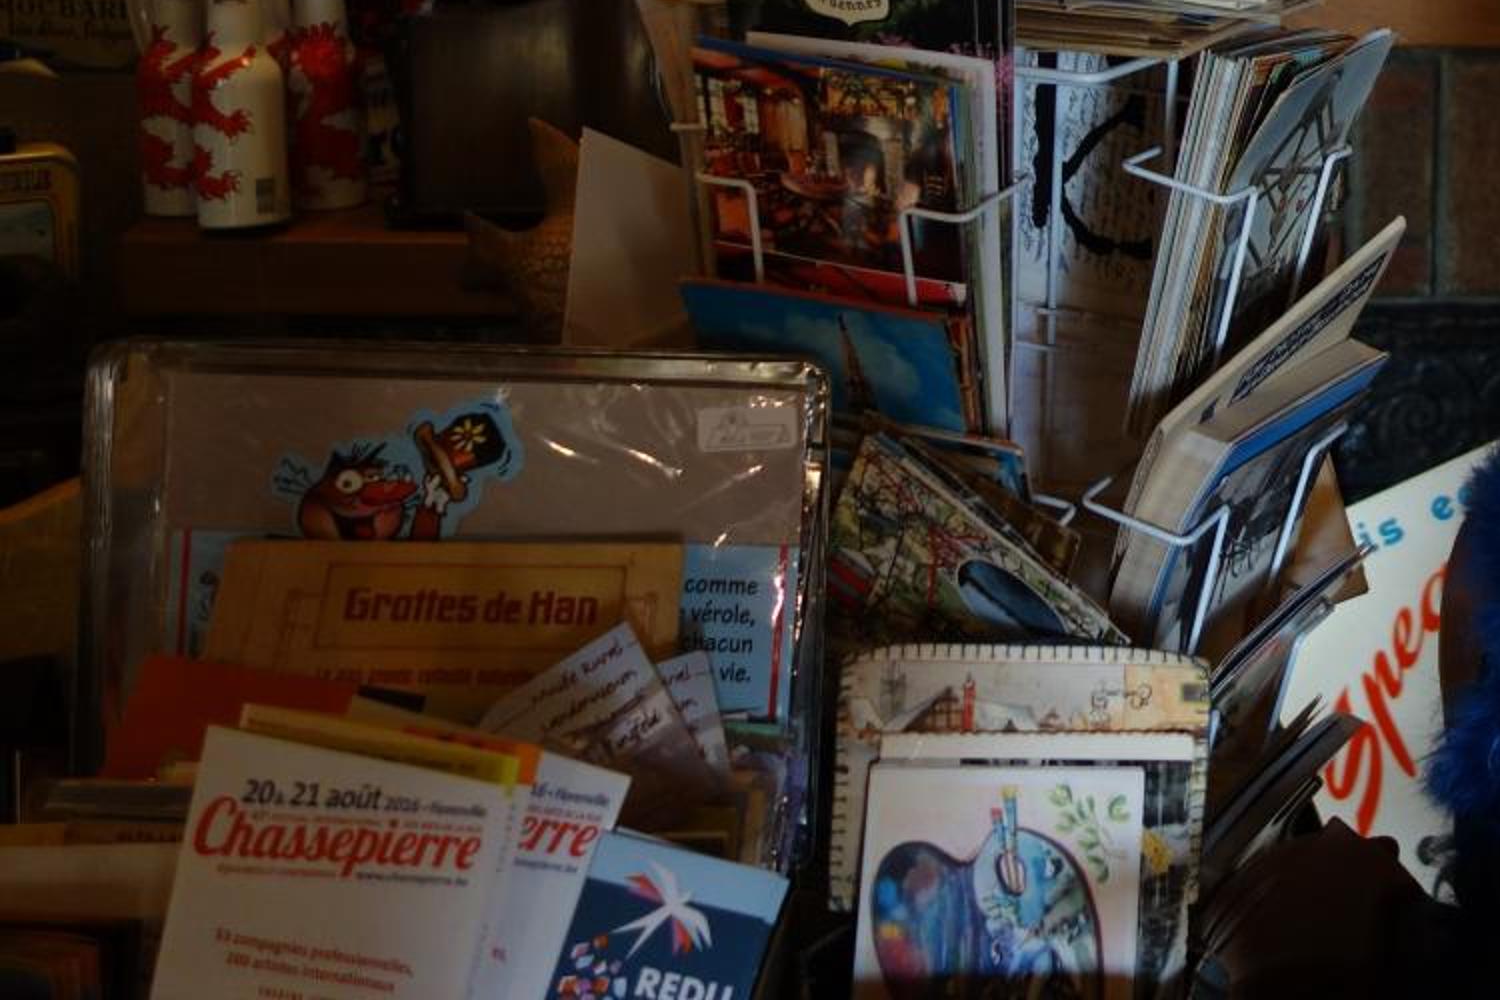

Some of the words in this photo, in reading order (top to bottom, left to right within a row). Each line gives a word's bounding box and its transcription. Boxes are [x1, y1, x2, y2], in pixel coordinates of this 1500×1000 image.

[684, 579, 759, 594] comme
[342, 586, 477, 623] Grottes
[482, 590, 523, 623] de
[527, 590, 599, 625] Han
[720, 661, 751, 682] vie.
[242, 778, 275, 803] 20
[291, 781, 320, 808] 21
[324, 785, 382, 810] août
[193, 794, 482, 879] Chassepierre
